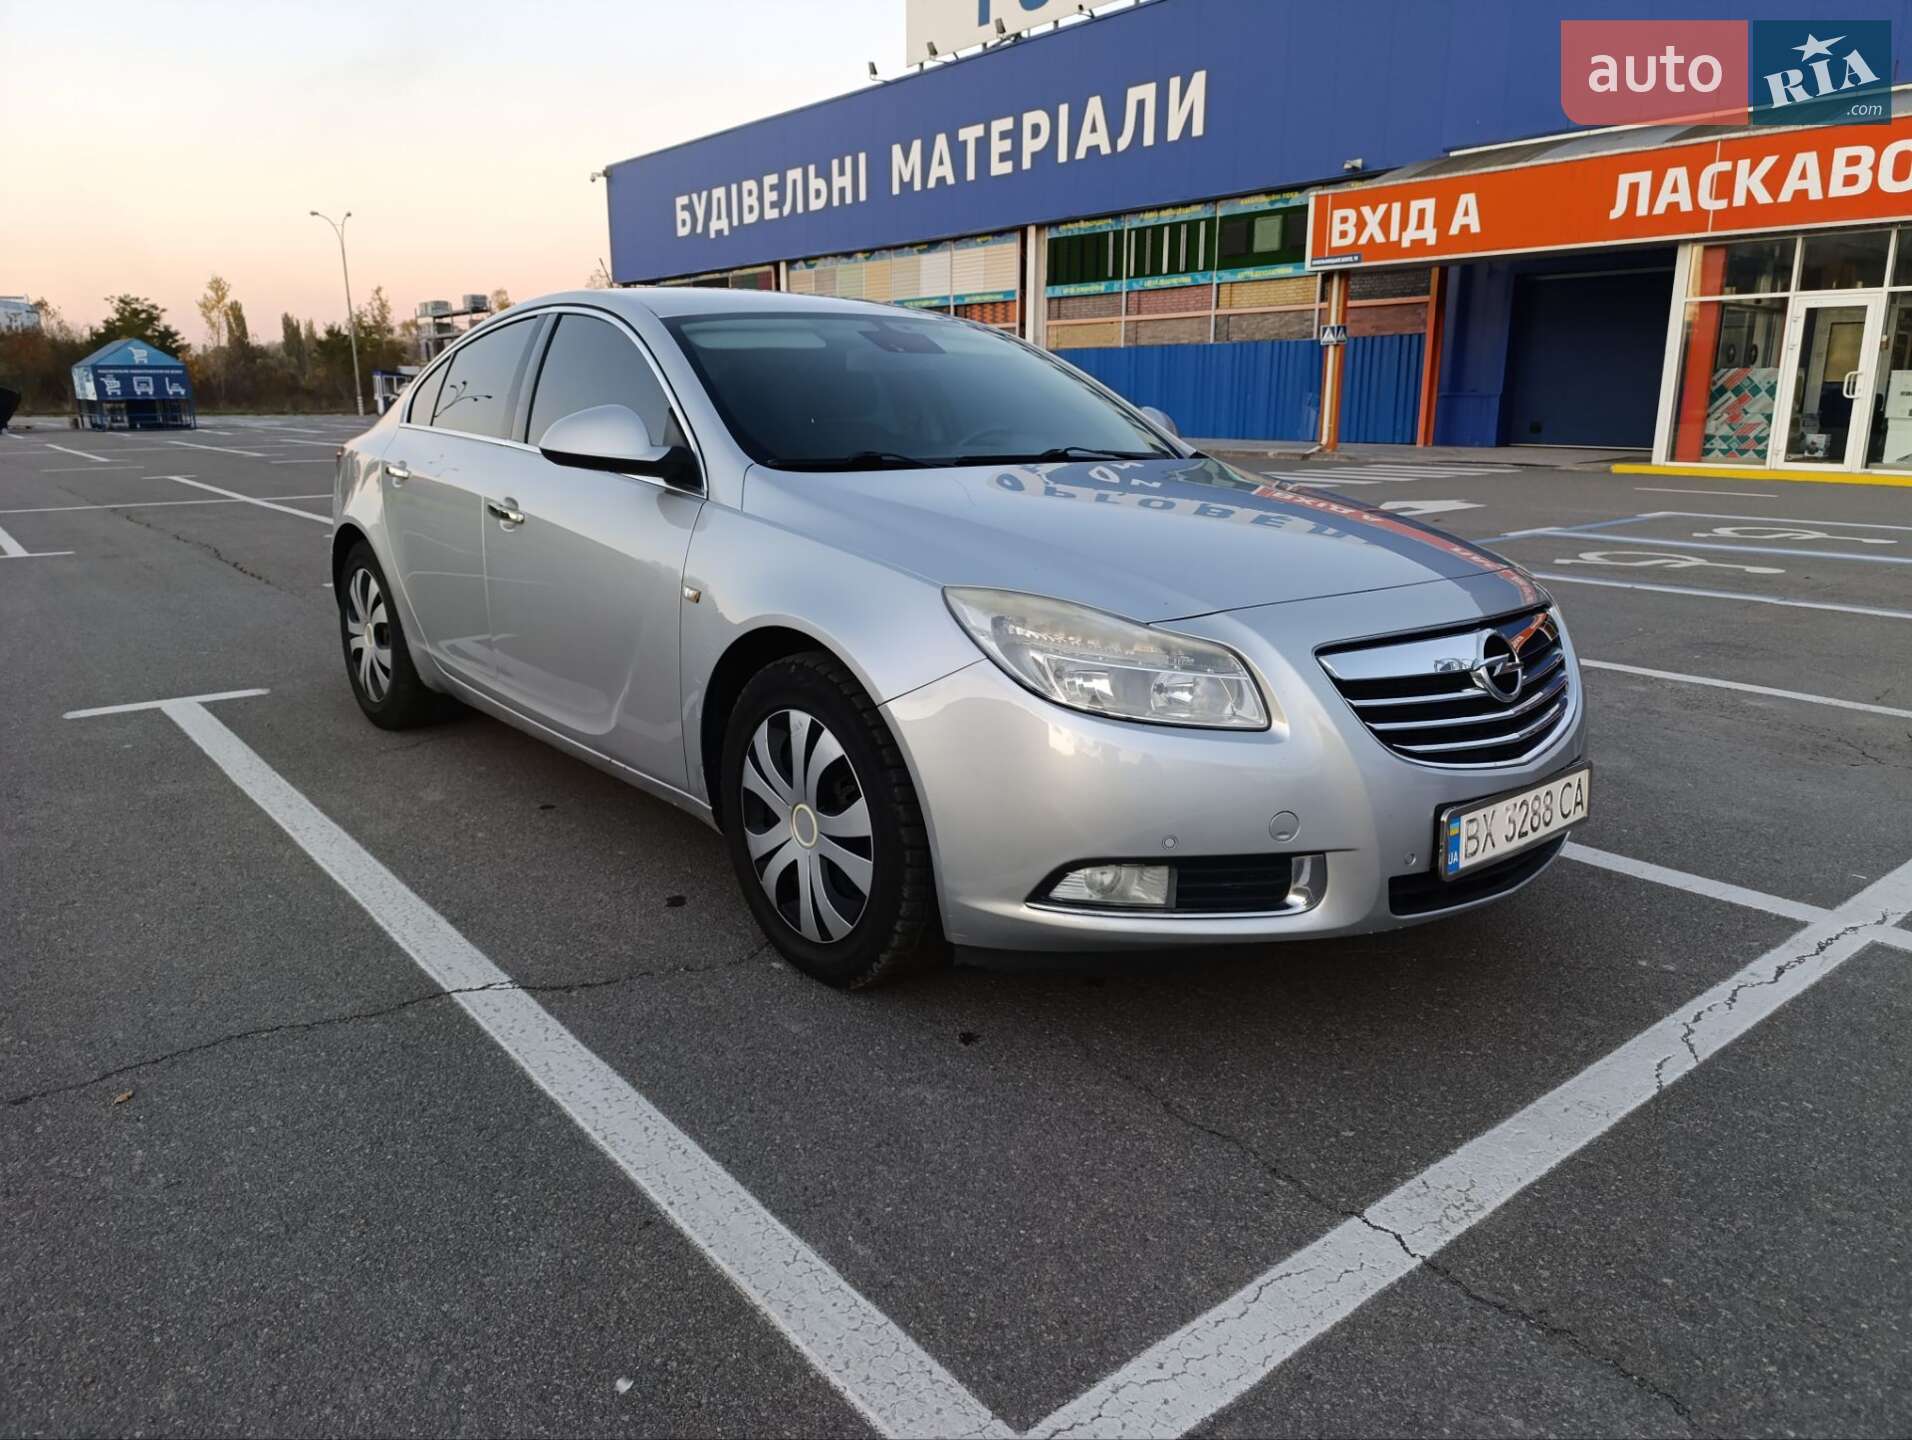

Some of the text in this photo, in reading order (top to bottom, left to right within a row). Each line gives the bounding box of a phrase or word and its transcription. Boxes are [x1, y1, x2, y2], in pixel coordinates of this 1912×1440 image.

[674, 69, 1207, 239] БУДІВЕЛЬНІ МАТЕРІАЛИ
[1609, 138, 1912, 220] ЛАСКАВО
[1330, 192, 1481, 248] ВХІД А
[1448, 850, 1459, 866] UA
[1464, 777, 1584, 860] BX 3288 CA
